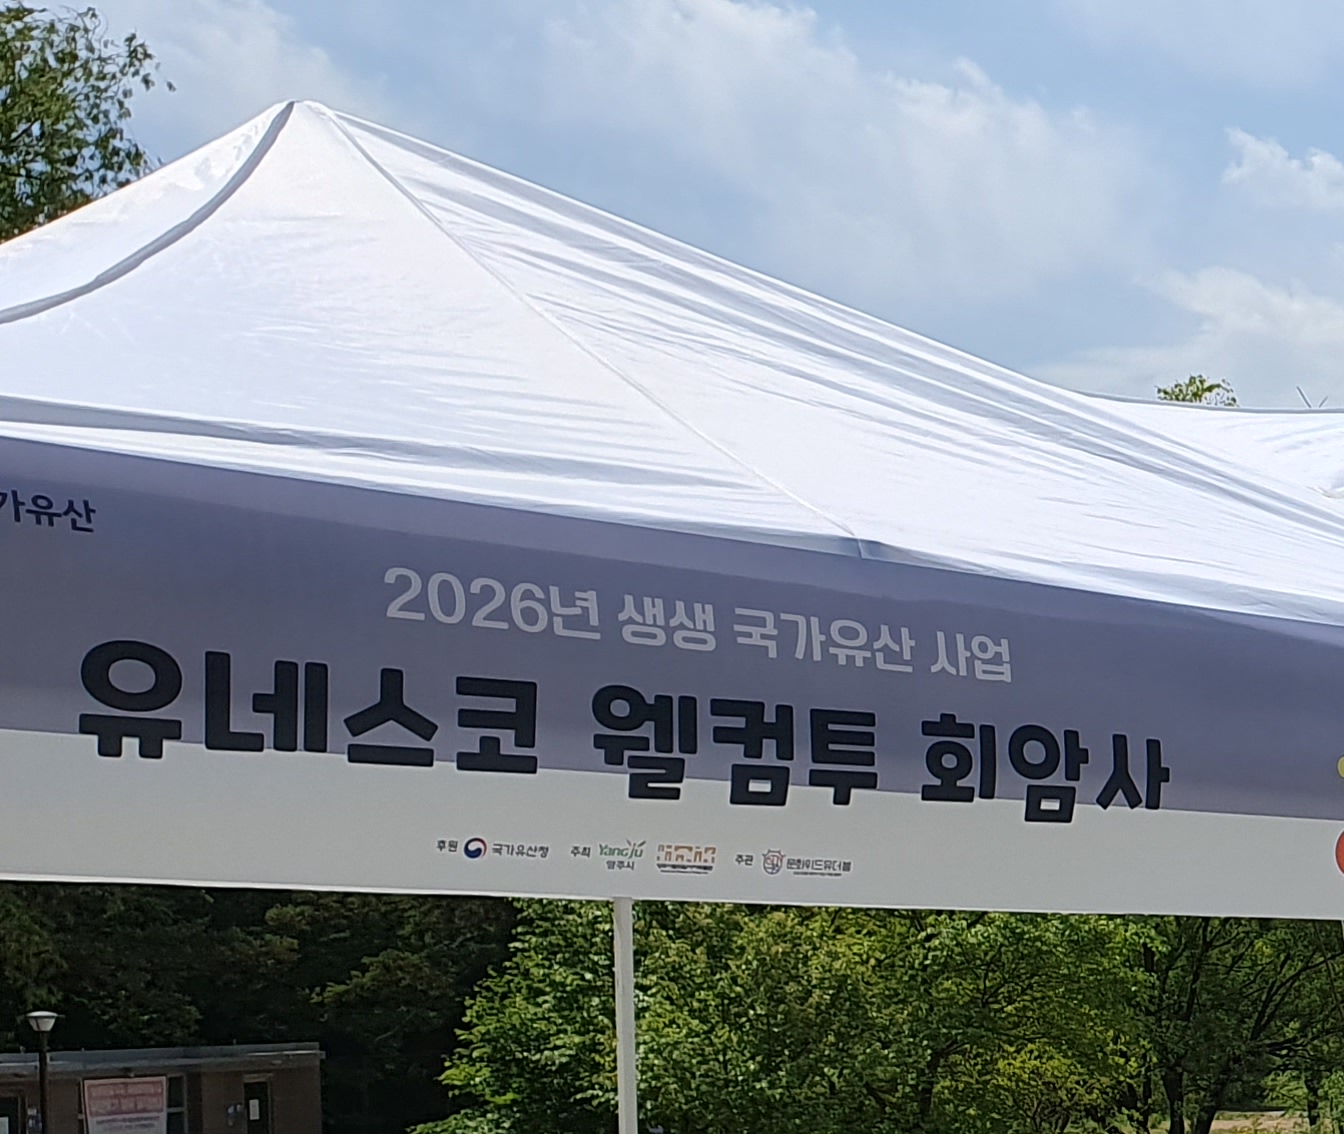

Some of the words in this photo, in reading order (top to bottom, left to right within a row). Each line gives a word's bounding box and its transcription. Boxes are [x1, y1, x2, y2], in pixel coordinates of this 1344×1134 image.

[384, 567, 600, 640] 2026년
[617, 594, 717, 652] 생생
[733, 607, 916, 673] 국가유산
[930, 631, 1012, 683] 사업
[79, 640, 538, 774] 유네스코
[591, 684, 879, 806] 웰컴투
[920, 712, 1170, 823] 회암사
